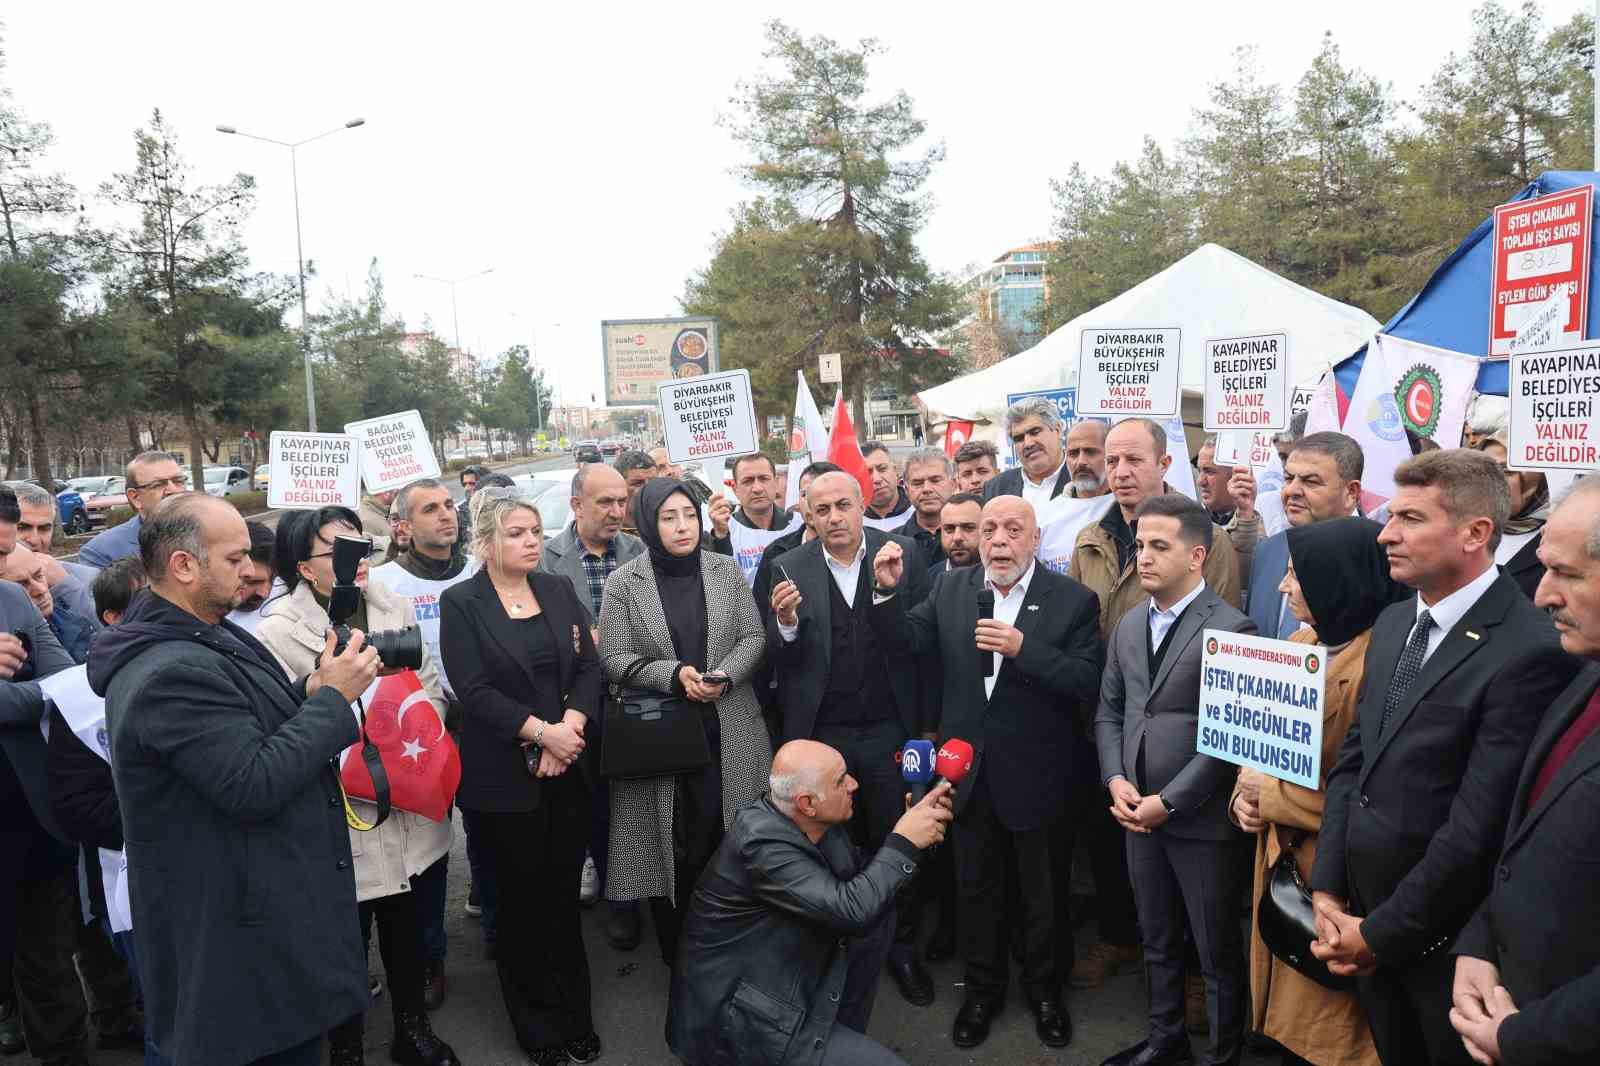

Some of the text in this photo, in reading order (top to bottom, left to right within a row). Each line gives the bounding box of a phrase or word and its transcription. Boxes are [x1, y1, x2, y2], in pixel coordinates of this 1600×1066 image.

[1508, 202, 1576, 234] İŞTEN ÇIKARILAN
[1503, 221, 1581, 251] TOPLAM İŞÇİ SAYISI
[1498, 288, 1526, 305] EYLEM
[1527, 283, 1547, 302] GÜN
[1097, 332, 1164, 345] DİYARBAKIR
[1094, 345, 1165, 359] BÜYÜKŞEHİR
[1213, 339, 1277, 357] KAYAPINAR
[1098, 359, 1159, 372] BELEDİYESİ
[1214, 354, 1276, 374] BELEDİYESİ
[1521, 353, 1600, 375] KAYAPINA
[1106, 372, 1149, 386] İŞÇİLERİ
[1222, 373, 1267, 393] İŞÇİLERİ
[1522, 373, 1600, 396] BELEDİYES
[673, 381, 732, 399] DİYARBAKIR
[1108, 386, 1147, 397] YALNIZ
[673, 392, 736, 411] BÜYÜKŞEHİR
[1100, 397, 1152, 409] DEĞİLDİR
[1225, 394, 1264, 407] YALNIZ
[1533, 396, 1592, 422] İŞÇİLERİ
[680, 405, 733, 423] BELEDİYESİ
[1217, 407, 1270, 425] DEĞİLDİR
[367, 421, 406, 437] BAĞLAR
[689, 417, 727, 434] İŞÇİLERİ
[1536, 423, 1588, 440] YALNIZ
[280, 438, 351, 451] KAYAPINAR
[364, 430, 416, 449] BELEDİYESİ
[693, 430, 727, 443] YALNIZ
[281, 450, 349, 464] BELEDİYESİ
[375, 442, 412, 461] İŞÇİLERİ
[688, 441, 734, 456] DEĞİLDİR
[1525, 442, 1596, 463] DEĞİLDİR
[383, 454, 415, 468] YALNIZ
[290, 463, 339, 479] İŞÇİLERİ
[379, 463, 424, 482] DEĞİLDİR
[294, 479, 336, 490] YALNIZ
[284, 489, 343, 503] DEĞİLDİR
[1241, 647, 1302, 667] KONFEDERASYONU
[1204, 661, 1319, 711] İŞTEN ÇIKARMALAR
[1205, 700, 1312, 746] ve SÜRGÜNLER
[1201, 726, 1313, 779] SON BULUNSUN
